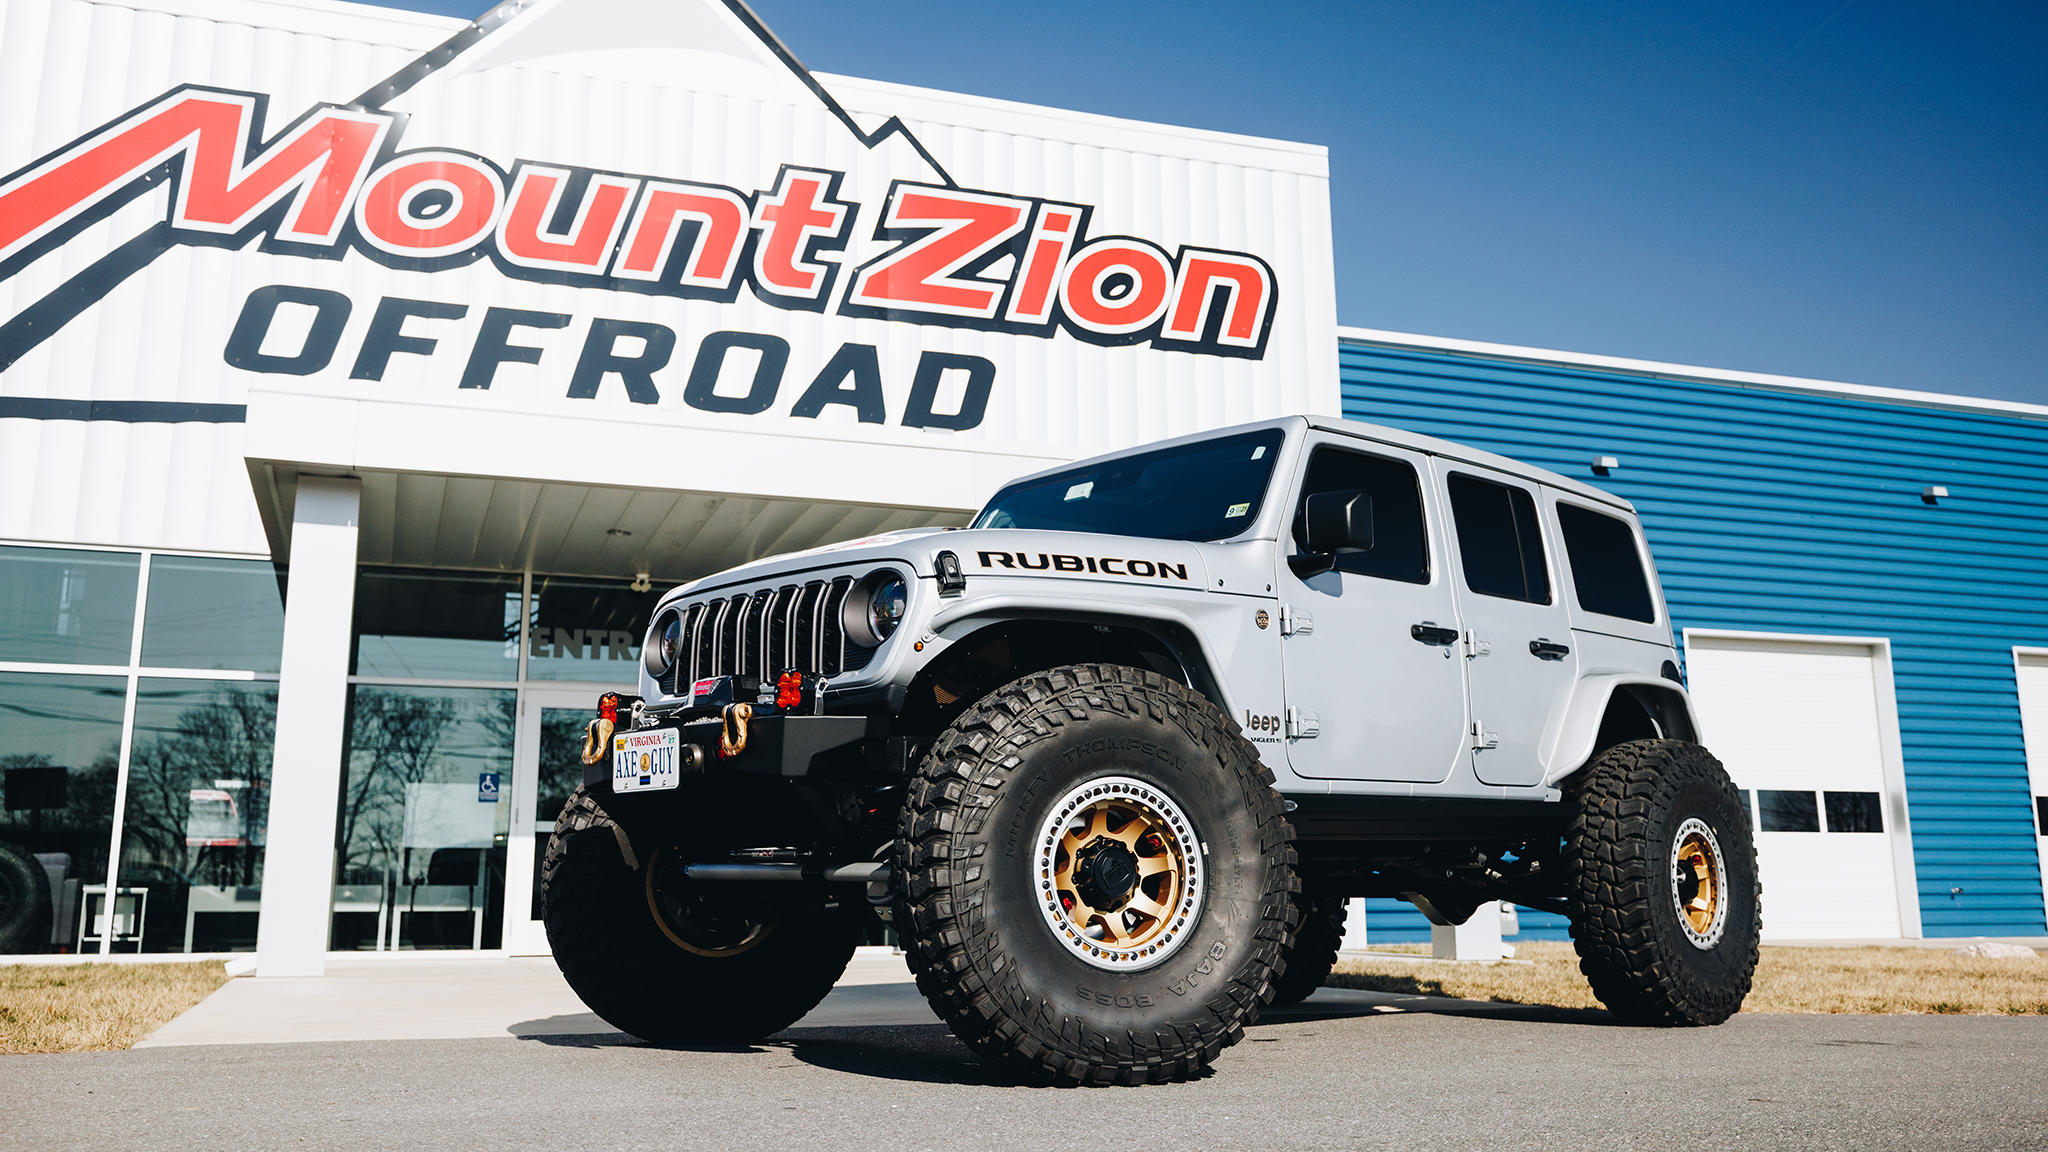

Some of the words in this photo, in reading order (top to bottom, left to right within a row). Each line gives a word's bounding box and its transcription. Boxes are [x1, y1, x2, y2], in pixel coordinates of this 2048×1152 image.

[0, 88, 850, 301] Mount
[848, 182, 1274, 349] Zion
[223, 284, 996, 432] OFFROAD
[976, 550, 1189, 581] RUBICON
[530, 627, 641, 661] ENTR
[1245, 709, 1281, 735] Jeep
[629, 734, 662, 747] VIRGINIA
[1062, 736, 1188, 772] THOMPSON
[616, 750, 638, 778] AXE
[651, 746, 674, 775] GUY
[1166, 940, 1228, 998] BAJA
[1074, 983, 1155, 1009] BOSS
